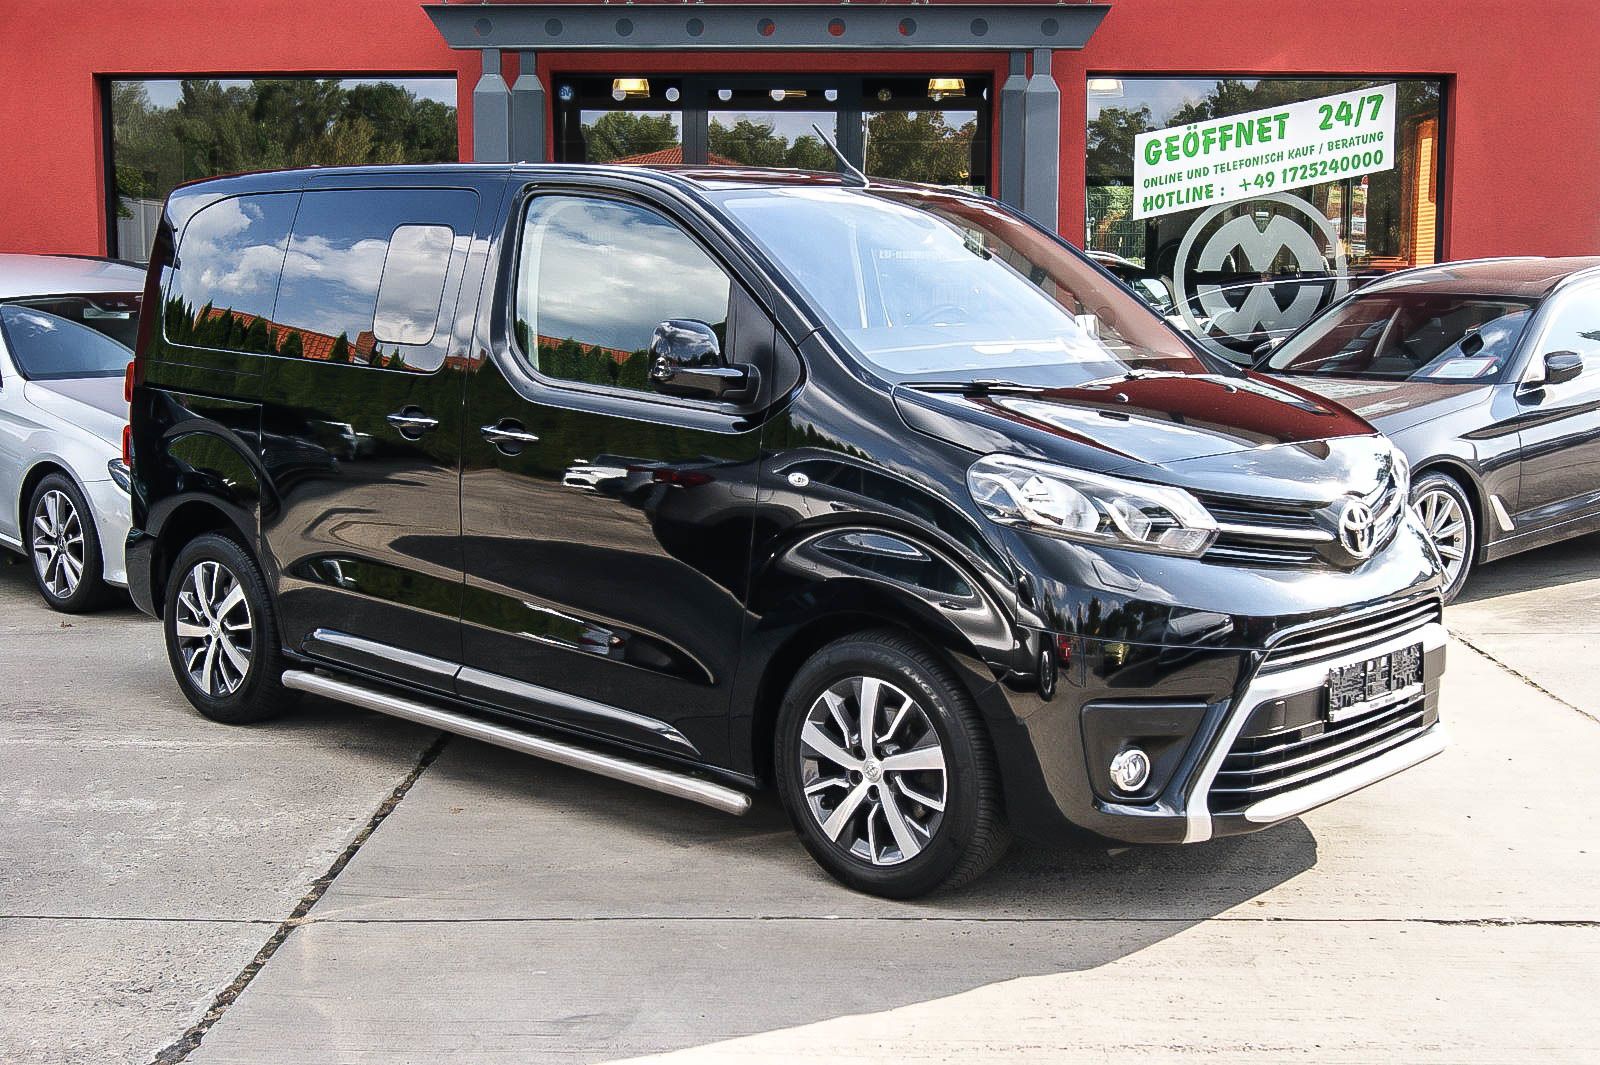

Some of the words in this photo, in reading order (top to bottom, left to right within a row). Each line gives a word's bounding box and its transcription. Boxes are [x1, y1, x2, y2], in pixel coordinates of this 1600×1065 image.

[1143, 171, 1183, 189] ONLINE
[1187, 166, 1210, 181] UND
[1213, 151, 1284, 176] TELEFONISCH
[1287, 144, 1316, 160] KAUF
[1327, 131, 1385, 152] BERATUNG
[1144, 112, 1290, 166] GEÖFFNET
[1318, 93, 1385, 132] 24/7
[1142, 183, 1214, 213] HOTLINE
[1238, 171, 1276, 192] +49
[1281, 149, 1385, 184] 1725240000
